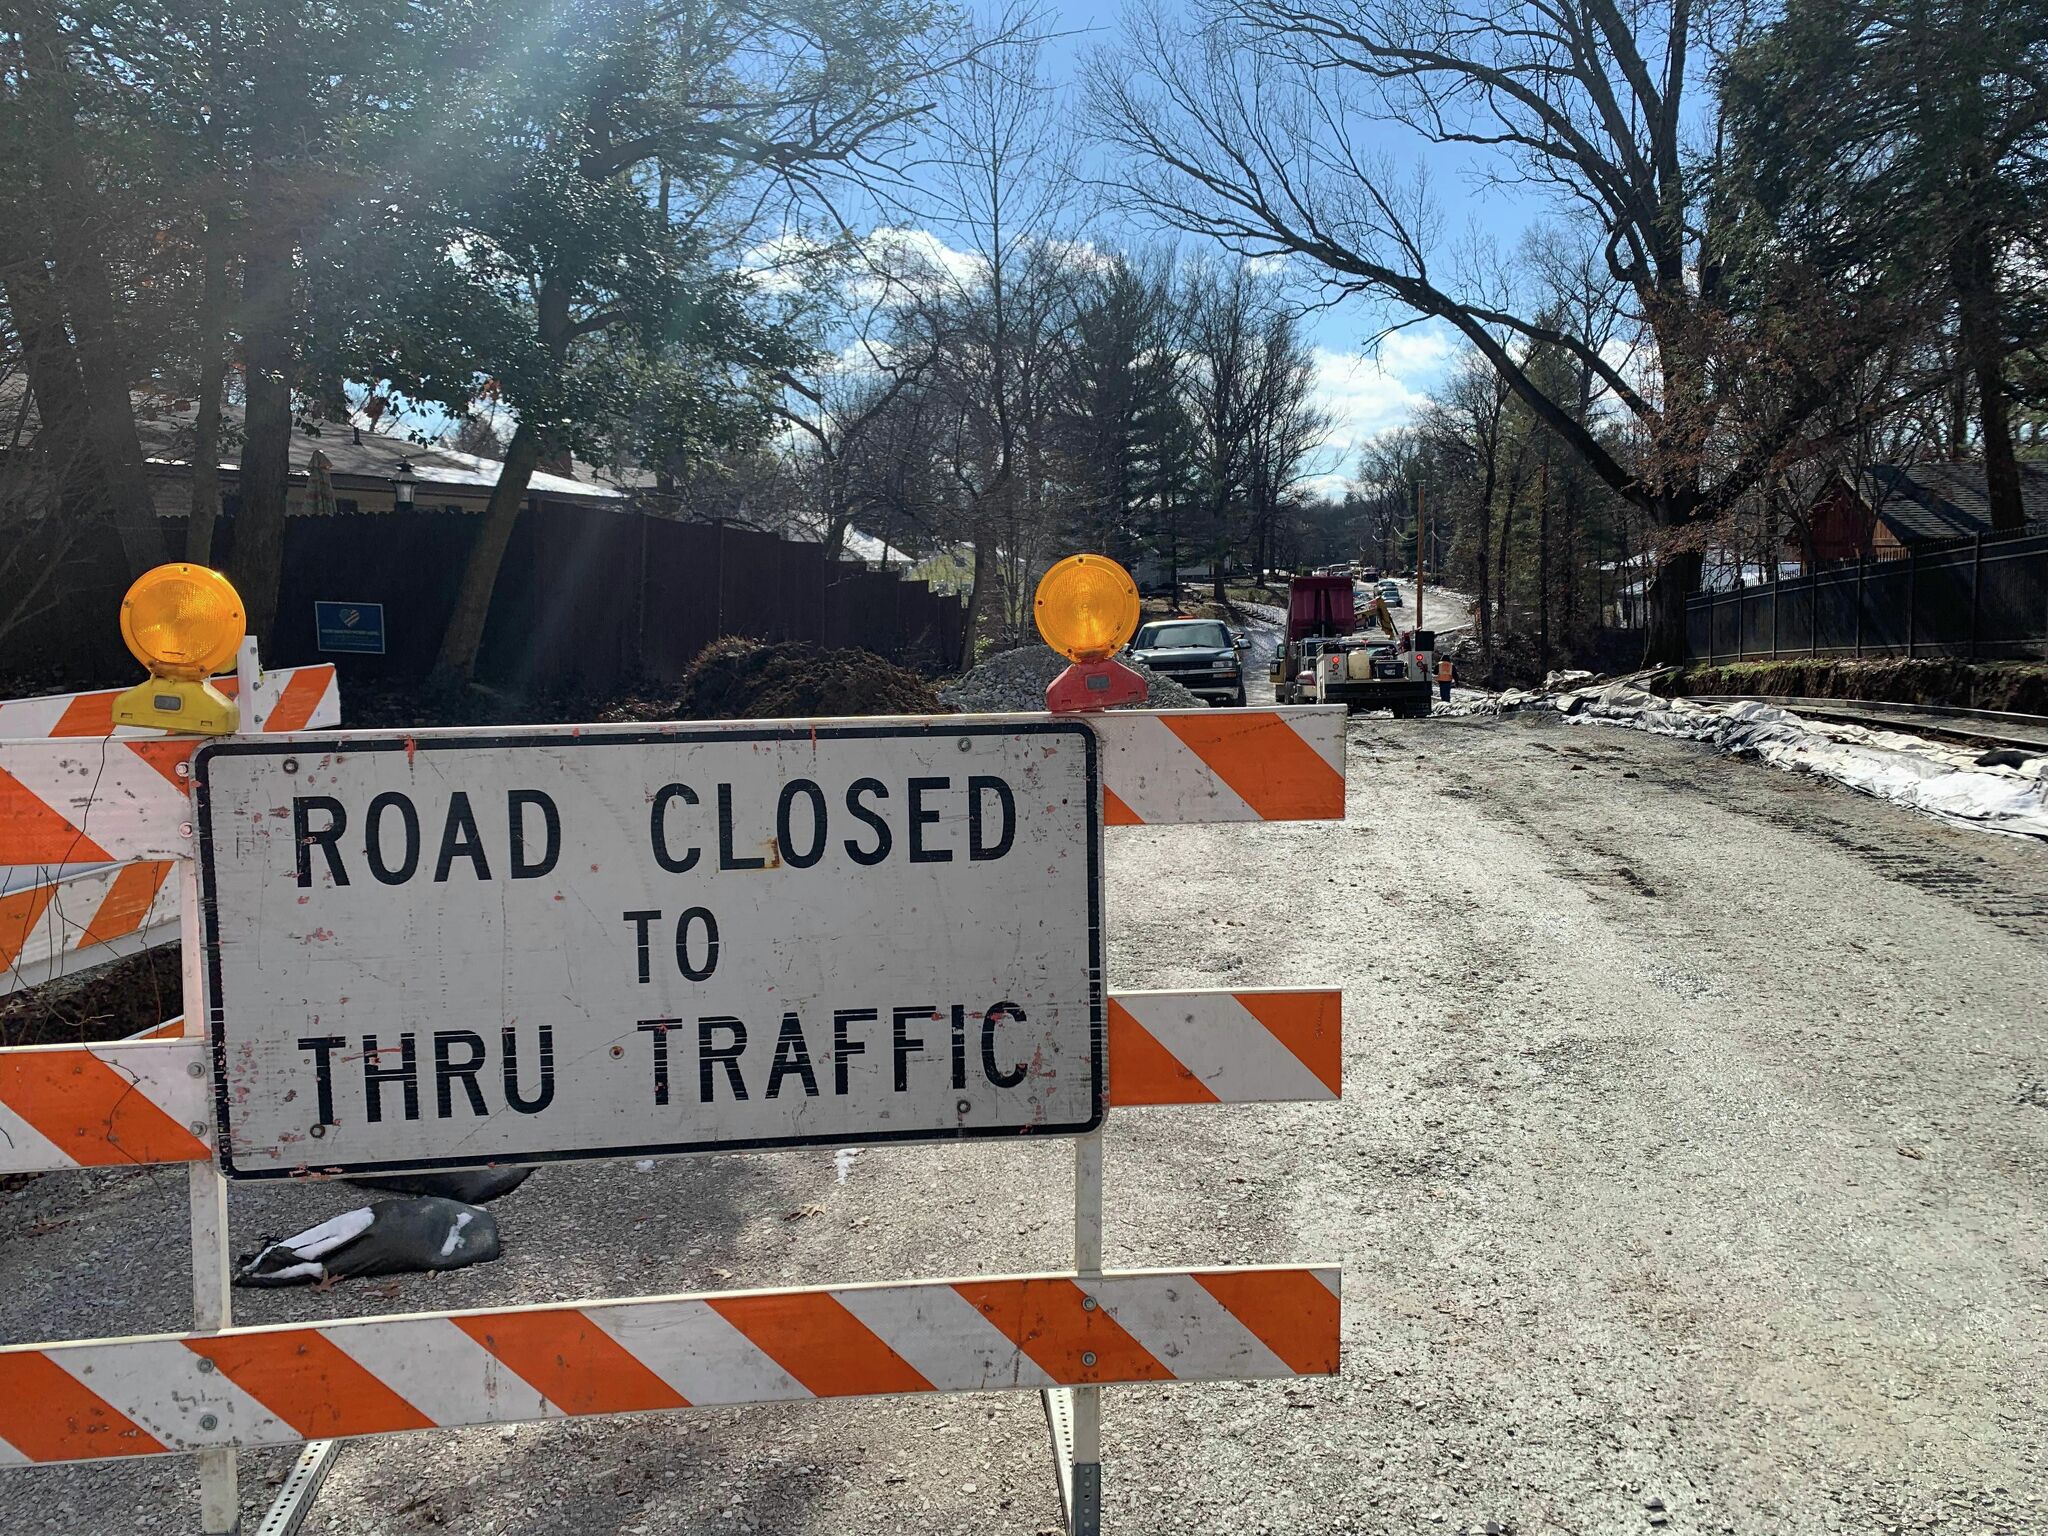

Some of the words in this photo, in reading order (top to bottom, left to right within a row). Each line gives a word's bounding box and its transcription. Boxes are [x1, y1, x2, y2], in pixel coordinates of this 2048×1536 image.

[293, 790, 560, 888] ROAD
[650, 775, 1017, 874] CLOSED
[624, 906, 720, 983] TO
[298, 1025, 555, 1125] THRU
[637, 1001, 1028, 1106] TRAFFIC
